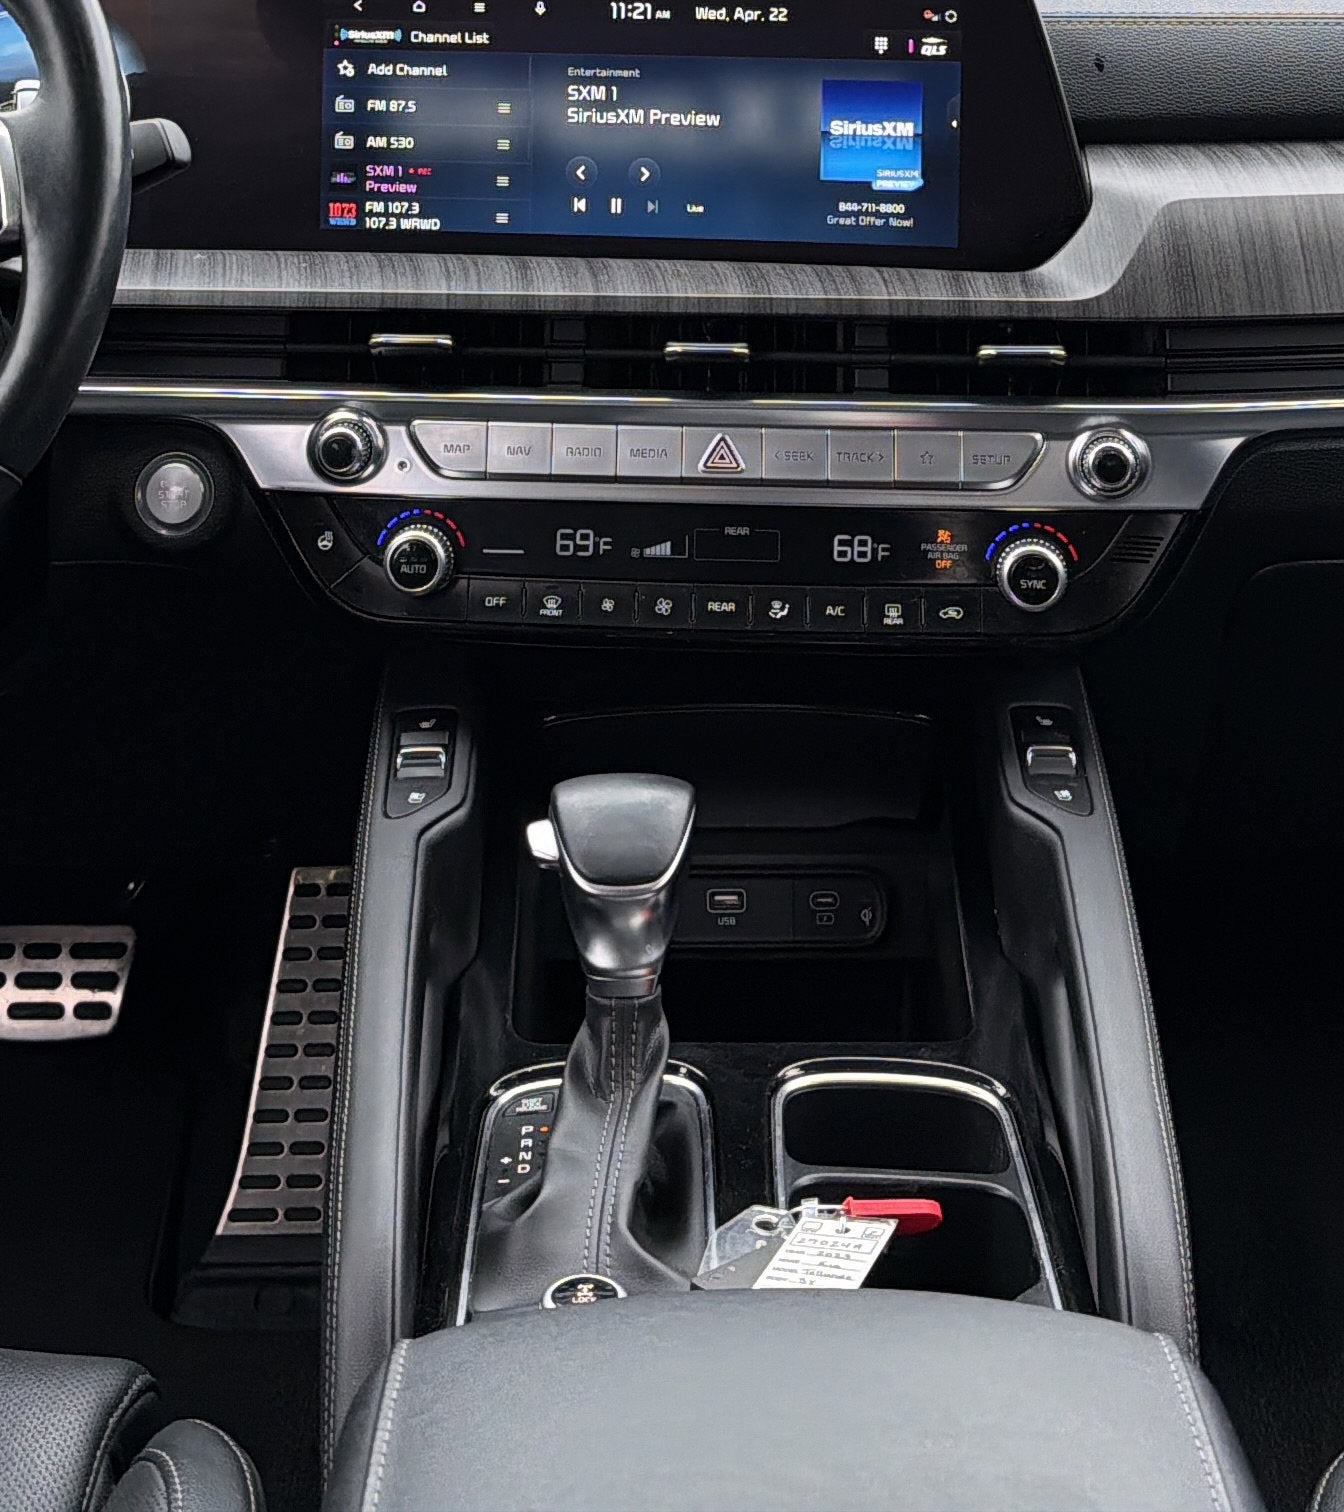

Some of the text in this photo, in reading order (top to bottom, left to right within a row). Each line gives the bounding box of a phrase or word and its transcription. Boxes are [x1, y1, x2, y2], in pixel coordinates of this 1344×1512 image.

[609, 1, 652, 20] 11:21
[733, 7, 765, 23] Apr.
[768, 7, 788, 22] 22
[410, 30, 490, 45] Channel List
[367, 62, 449, 77] Add Channel
[567, 66, 641, 79] Entertainment
[567, 85, 607, 101] SXM
[366, 99, 417, 113] FM 87.5
[567, 107, 721, 127] SiriusXM Preview
[829, 119, 915, 138] SiriusXM
[365, 136, 415, 149] AM 530
[365, 164, 397, 177] SXM
[365, 180, 418, 194] Preview
[364, 200, 420, 215] FM 107.3
[364, 216, 441, 231] 107.3 WRWD
[826, 214, 914, 228] Great Offer Now!
[442, 443, 471, 455] MAP
[505, 445, 531, 456] NAV
[565, 446, 602, 458] RADIO
[629, 447, 668, 459] MEDIA
[783, 450, 814, 462] SEEK
[836, 451, 875, 463] TRACK
[971, 453, 1011, 466] SETUP
[724, 526, 750, 536] REAR
[920, 543, 968, 552] PASSENGER
[399, 563, 427, 575] AUTO
[935, 559, 953, 569] OFF
[1020, 578, 1047, 590] SYNC
[484, 596, 506, 607] OFF
[707, 601, 736, 613] REAR
[539, 609, 564, 617] FRONT
[825, 605, 846, 617] A/C
[883, 617, 904, 626] REAR
[717, 916, 736, 926] USB
[521, 1125, 535, 1136] P
[518, 1150, 533, 1162] N
[516, 1163, 531, 1174] D
